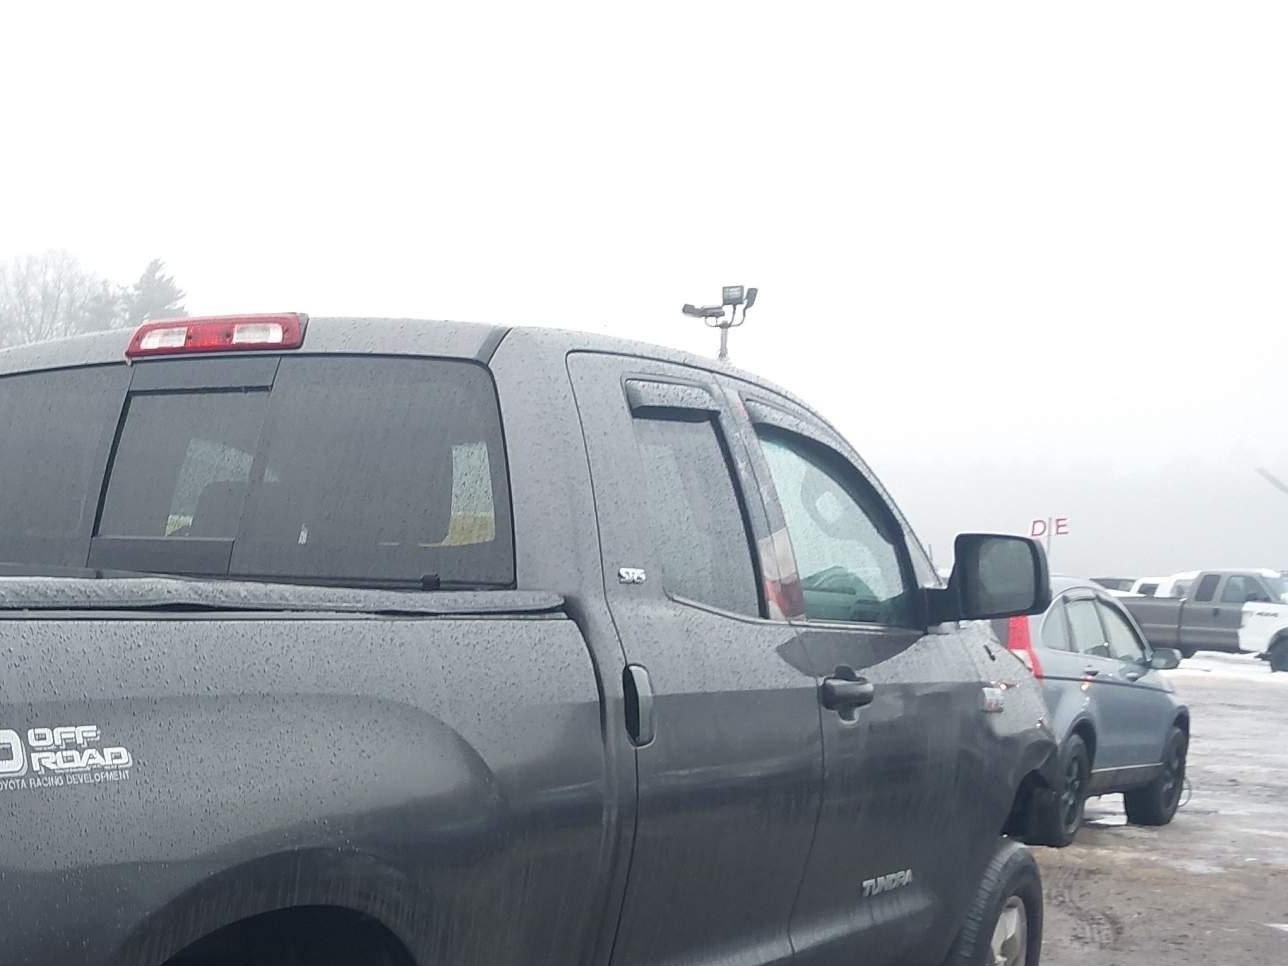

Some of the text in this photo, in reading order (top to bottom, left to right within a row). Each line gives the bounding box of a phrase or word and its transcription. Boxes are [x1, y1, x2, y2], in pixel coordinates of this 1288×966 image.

[27, 724, 101, 750] OFF
[29, 746, 133, 775] ROAD
[28, 776, 64, 790] RACING
[65, 769, 130, 786] DEVELOPMENT
[862, 868, 913, 897] TUNDRA
